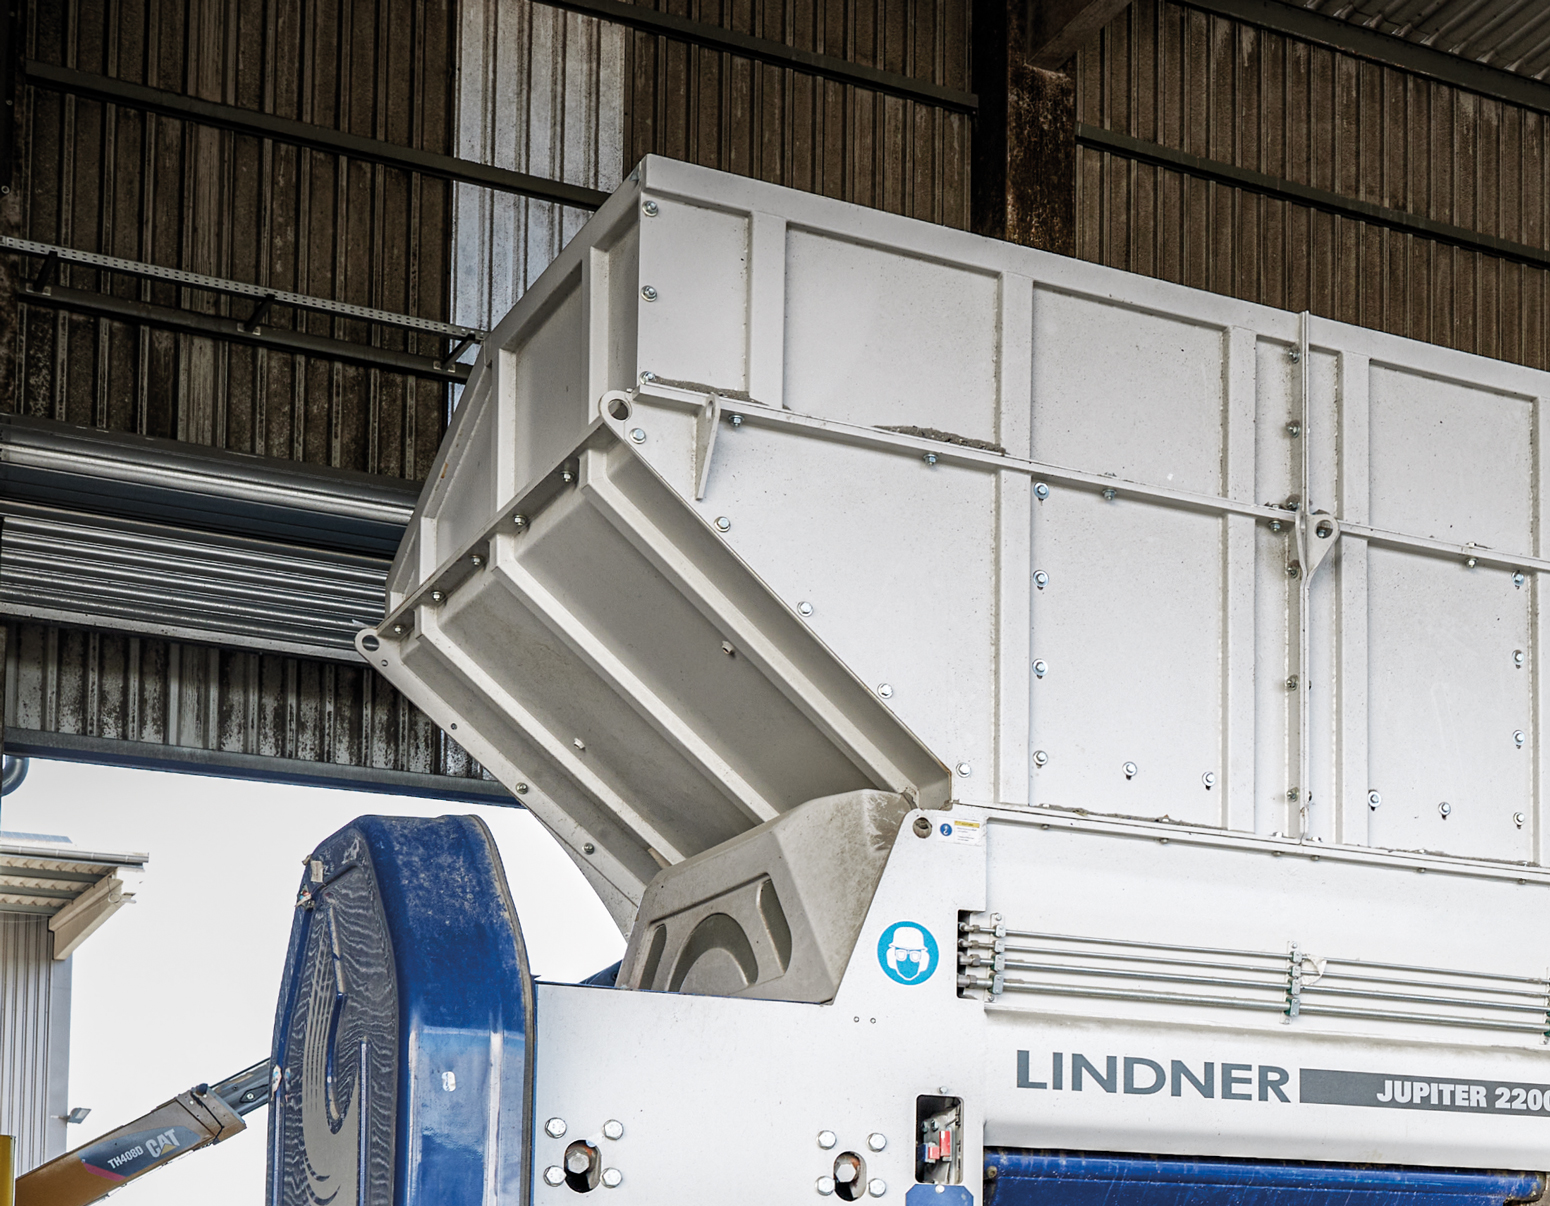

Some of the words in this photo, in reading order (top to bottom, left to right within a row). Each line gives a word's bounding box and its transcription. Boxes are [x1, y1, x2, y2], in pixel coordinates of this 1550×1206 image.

[1016, 1049, 1291, 1103] LINDNER
[1376, 1079, 1487, 1108] JUPITER
[107, 1145, 144, 1169] TH408D
[145, 1128, 180, 1158] CAT
